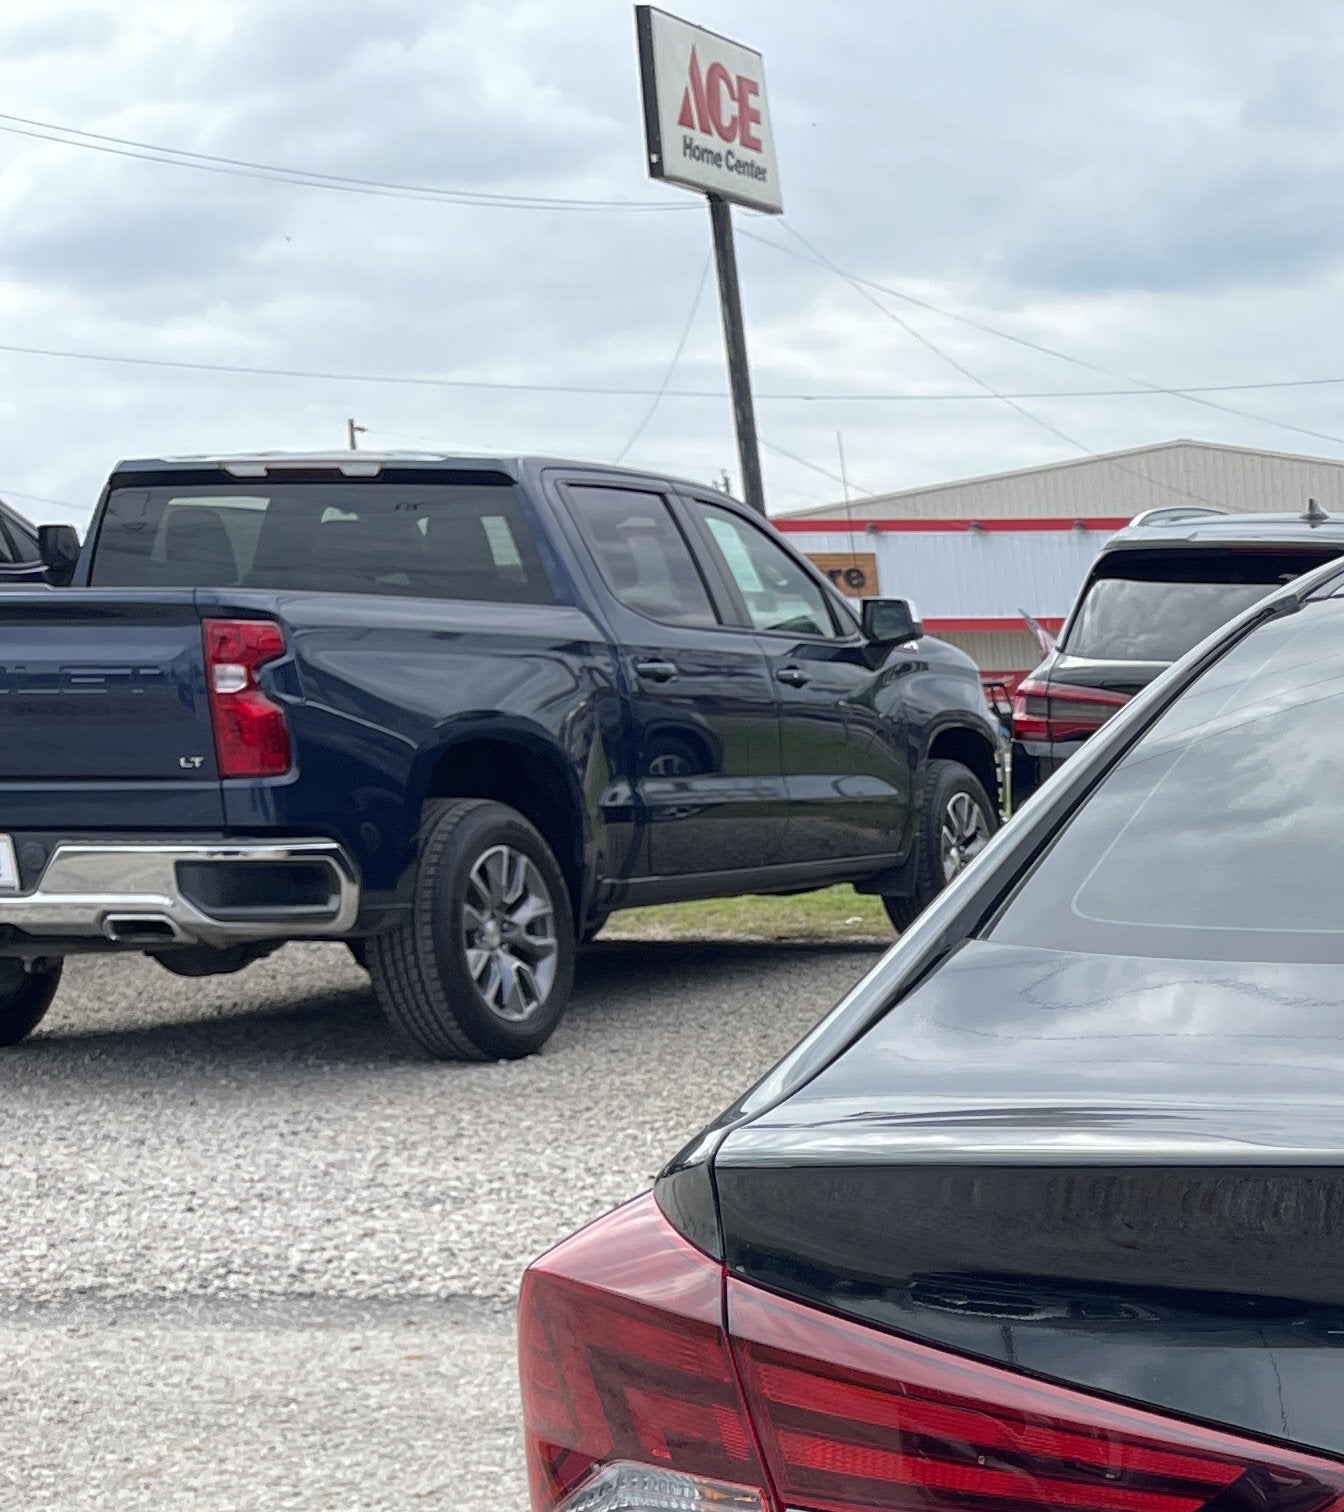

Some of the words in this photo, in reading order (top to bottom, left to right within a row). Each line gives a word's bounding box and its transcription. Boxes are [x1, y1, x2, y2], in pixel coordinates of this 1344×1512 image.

[678, 43, 762, 153] ACE
[683, 134, 722, 168] Home
[725, 149, 767, 182] Center
[179, 756, 204, 768] LT
